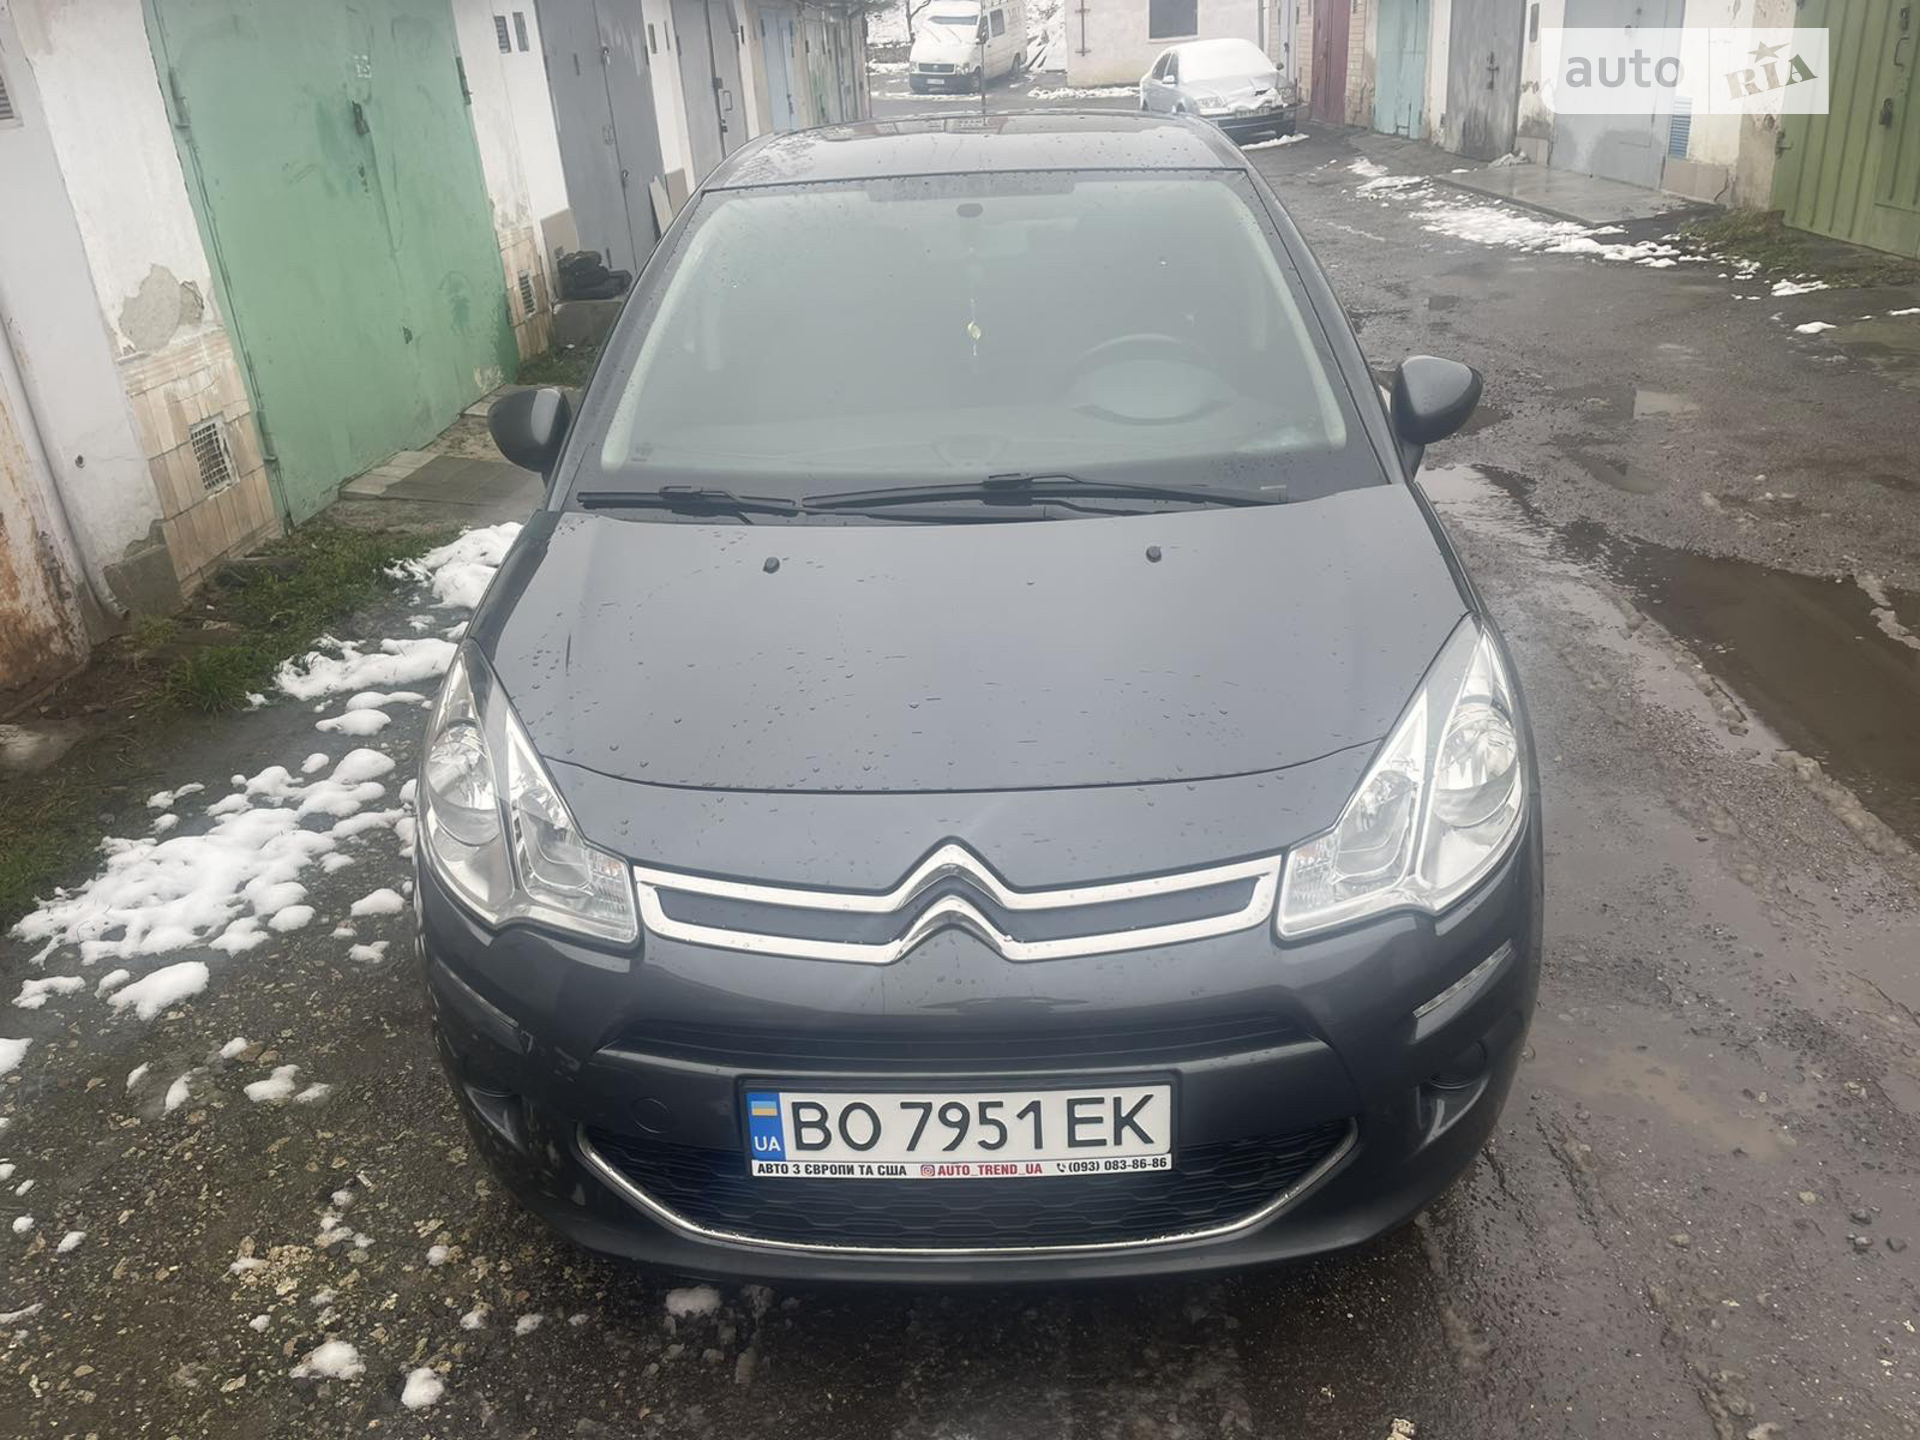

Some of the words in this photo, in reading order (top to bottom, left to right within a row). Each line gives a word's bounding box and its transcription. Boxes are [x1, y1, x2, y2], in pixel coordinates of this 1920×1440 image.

[900, 1101, 1044, 1151] 7951
[754, 1136, 780, 1153] UA
[757, 1163, 789, 1175] АВТО
[804, 1164, 855, 1176] ЄВРОПИ
[858, 1164, 874, 1176] ТА
[877, 1165, 907, 1176] США
[1068, 1161, 1100, 1173] (093)
[1104, 1157, 1167, 1171] 083-86-86
